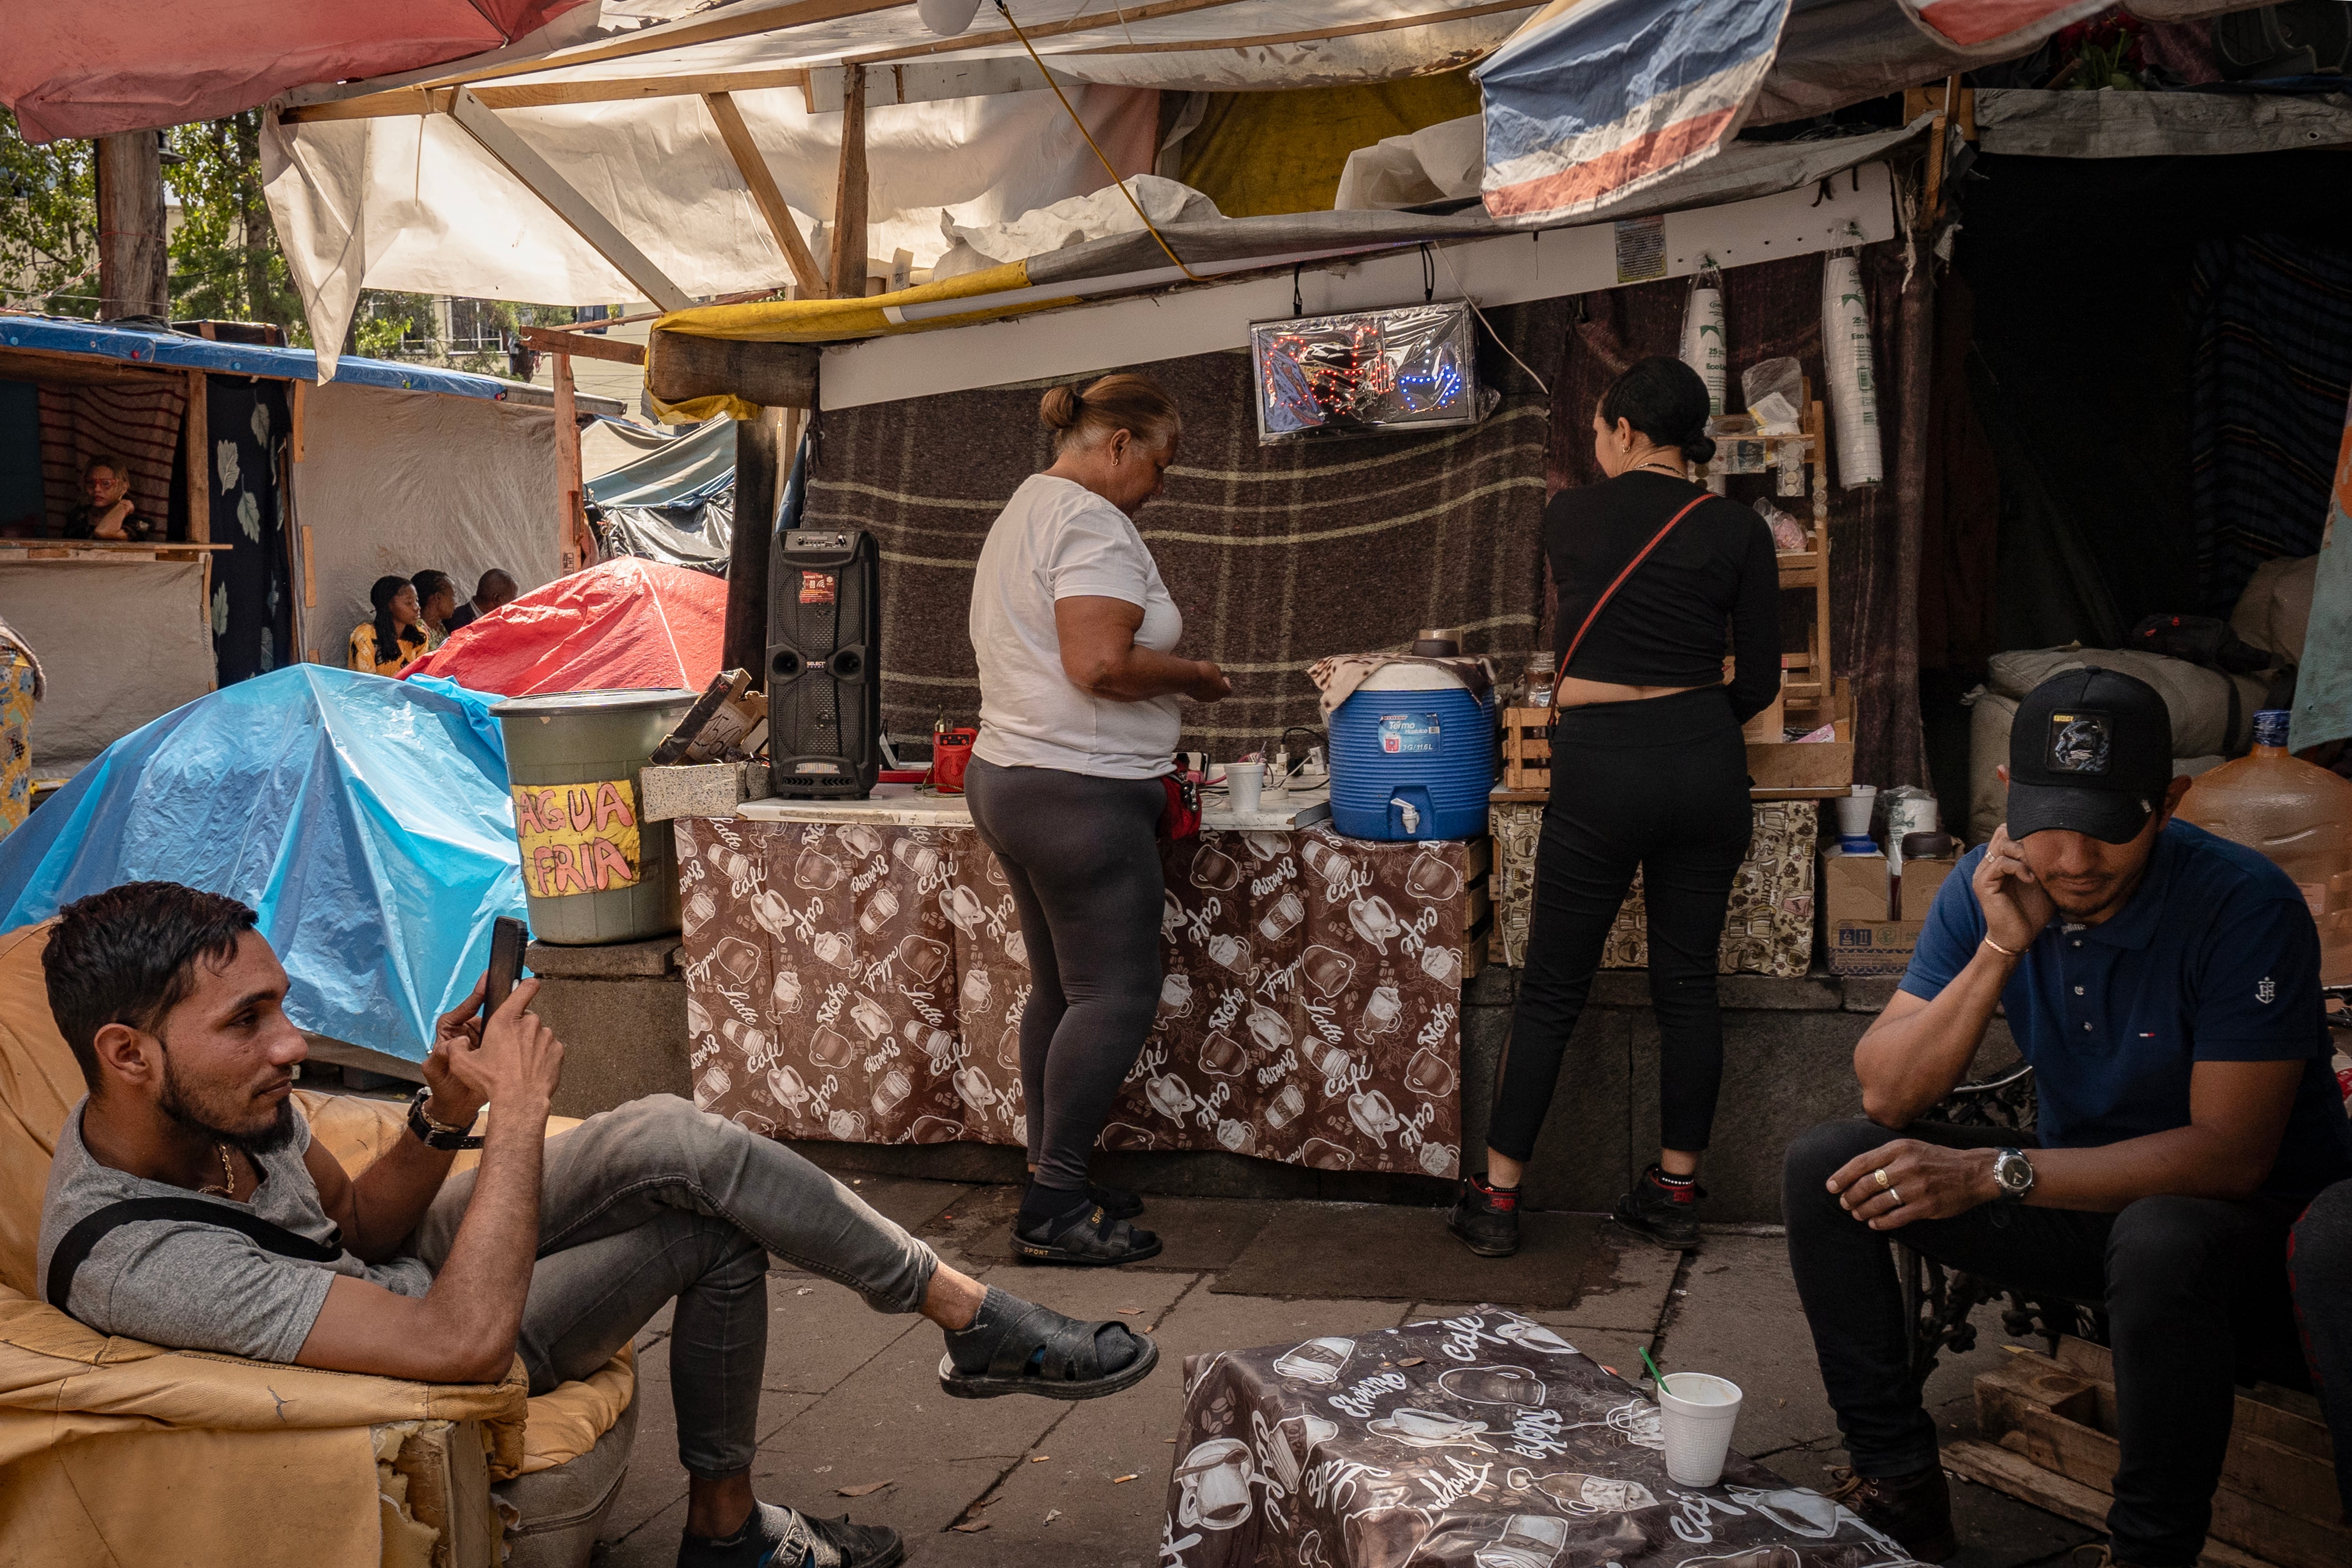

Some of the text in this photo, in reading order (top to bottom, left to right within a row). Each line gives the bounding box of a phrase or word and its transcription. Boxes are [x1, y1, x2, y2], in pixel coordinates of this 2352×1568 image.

[519, 783, 634, 838] AGUA
[534, 837, 633, 896] FRIA
[732, 857, 768, 899] Café
[917, 852, 959, 895] Café
[1327, 861, 1374, 903] Café
[793, 897, 824, 945] Café
[984, 894, 1015, 944] Café
[1186, 897, 1221, 947] Café
[1399, 907, 1438, 959] Café
[686, 947, 716, 993] Frappe
[860, 946, 898, 993] Frappe
[1256, 955, 1301, 1002] Frappe
[717, 983, 759, 1026] Latte
[899, 983, 945, 1027] Latte
[1300, 995, 1345, 1044] Latte
[747, 1035, 784, 1074] Café
[930, 1035, 972, 1076] Café
[1325, 1055, 1373, 1098] Café
[808, 1074, 838, 1122] Café
[995, 1078, 1023, 1126] Café
[1194, 1082, 1230, 1131] Café
[1398, 1102, 1435, 1154] Café
[1023, 1247, 1049, 1256] SPORT
[1305, 1458, 1391, 1514] Latte
